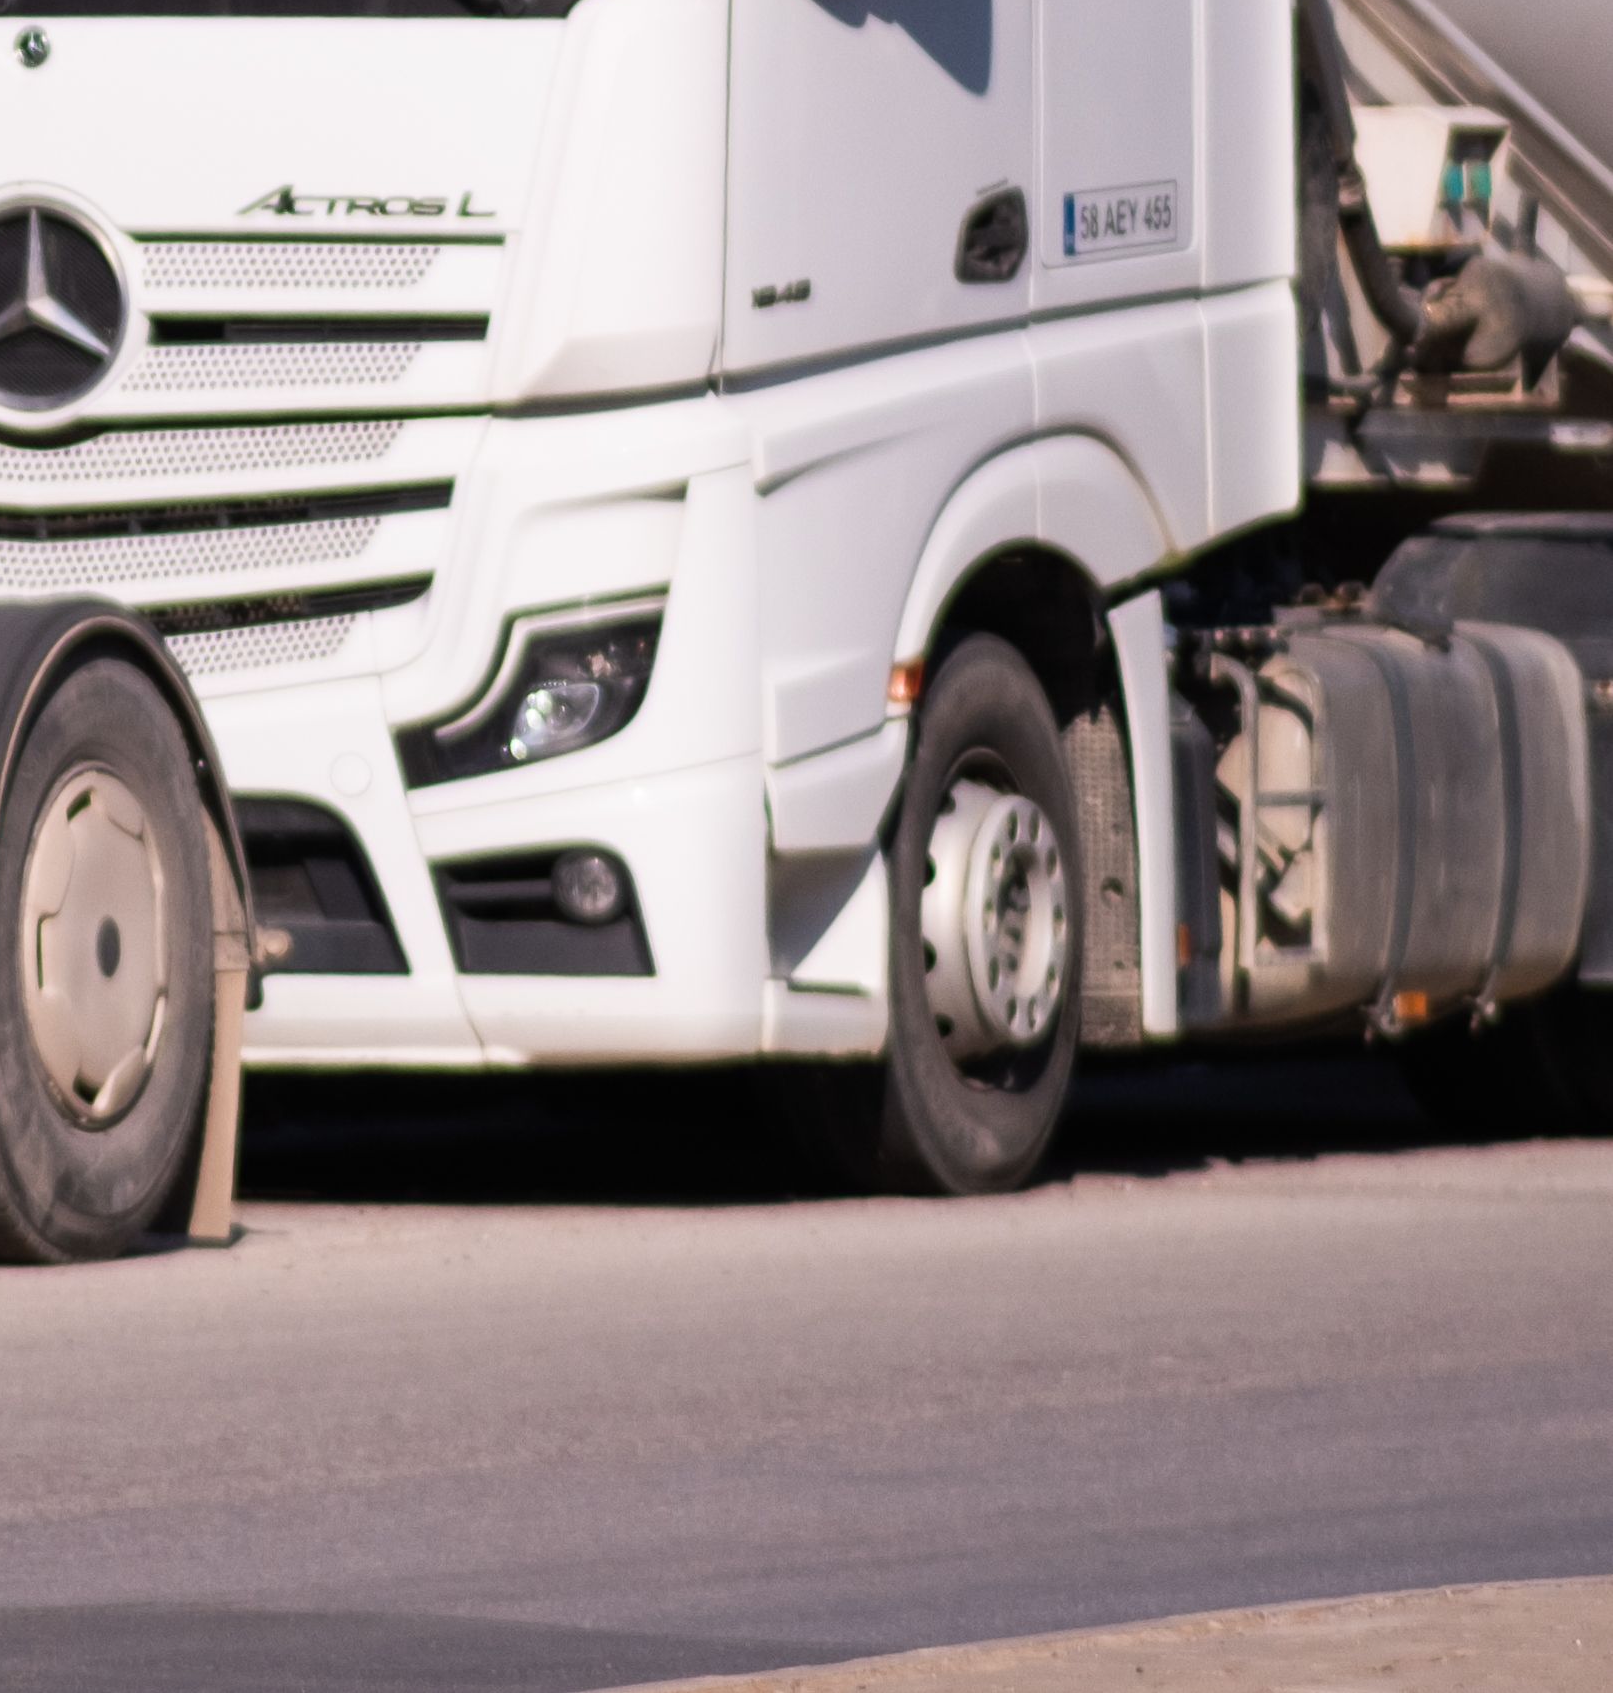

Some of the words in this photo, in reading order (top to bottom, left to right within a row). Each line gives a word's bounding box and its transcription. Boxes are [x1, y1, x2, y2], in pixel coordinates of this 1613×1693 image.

[456, 191, 496, 217] L
[1080, 202, 1098, 240] 58
[1104, 198, 1138, 237] AEY
[1143, 194, 1172, 231] 455
